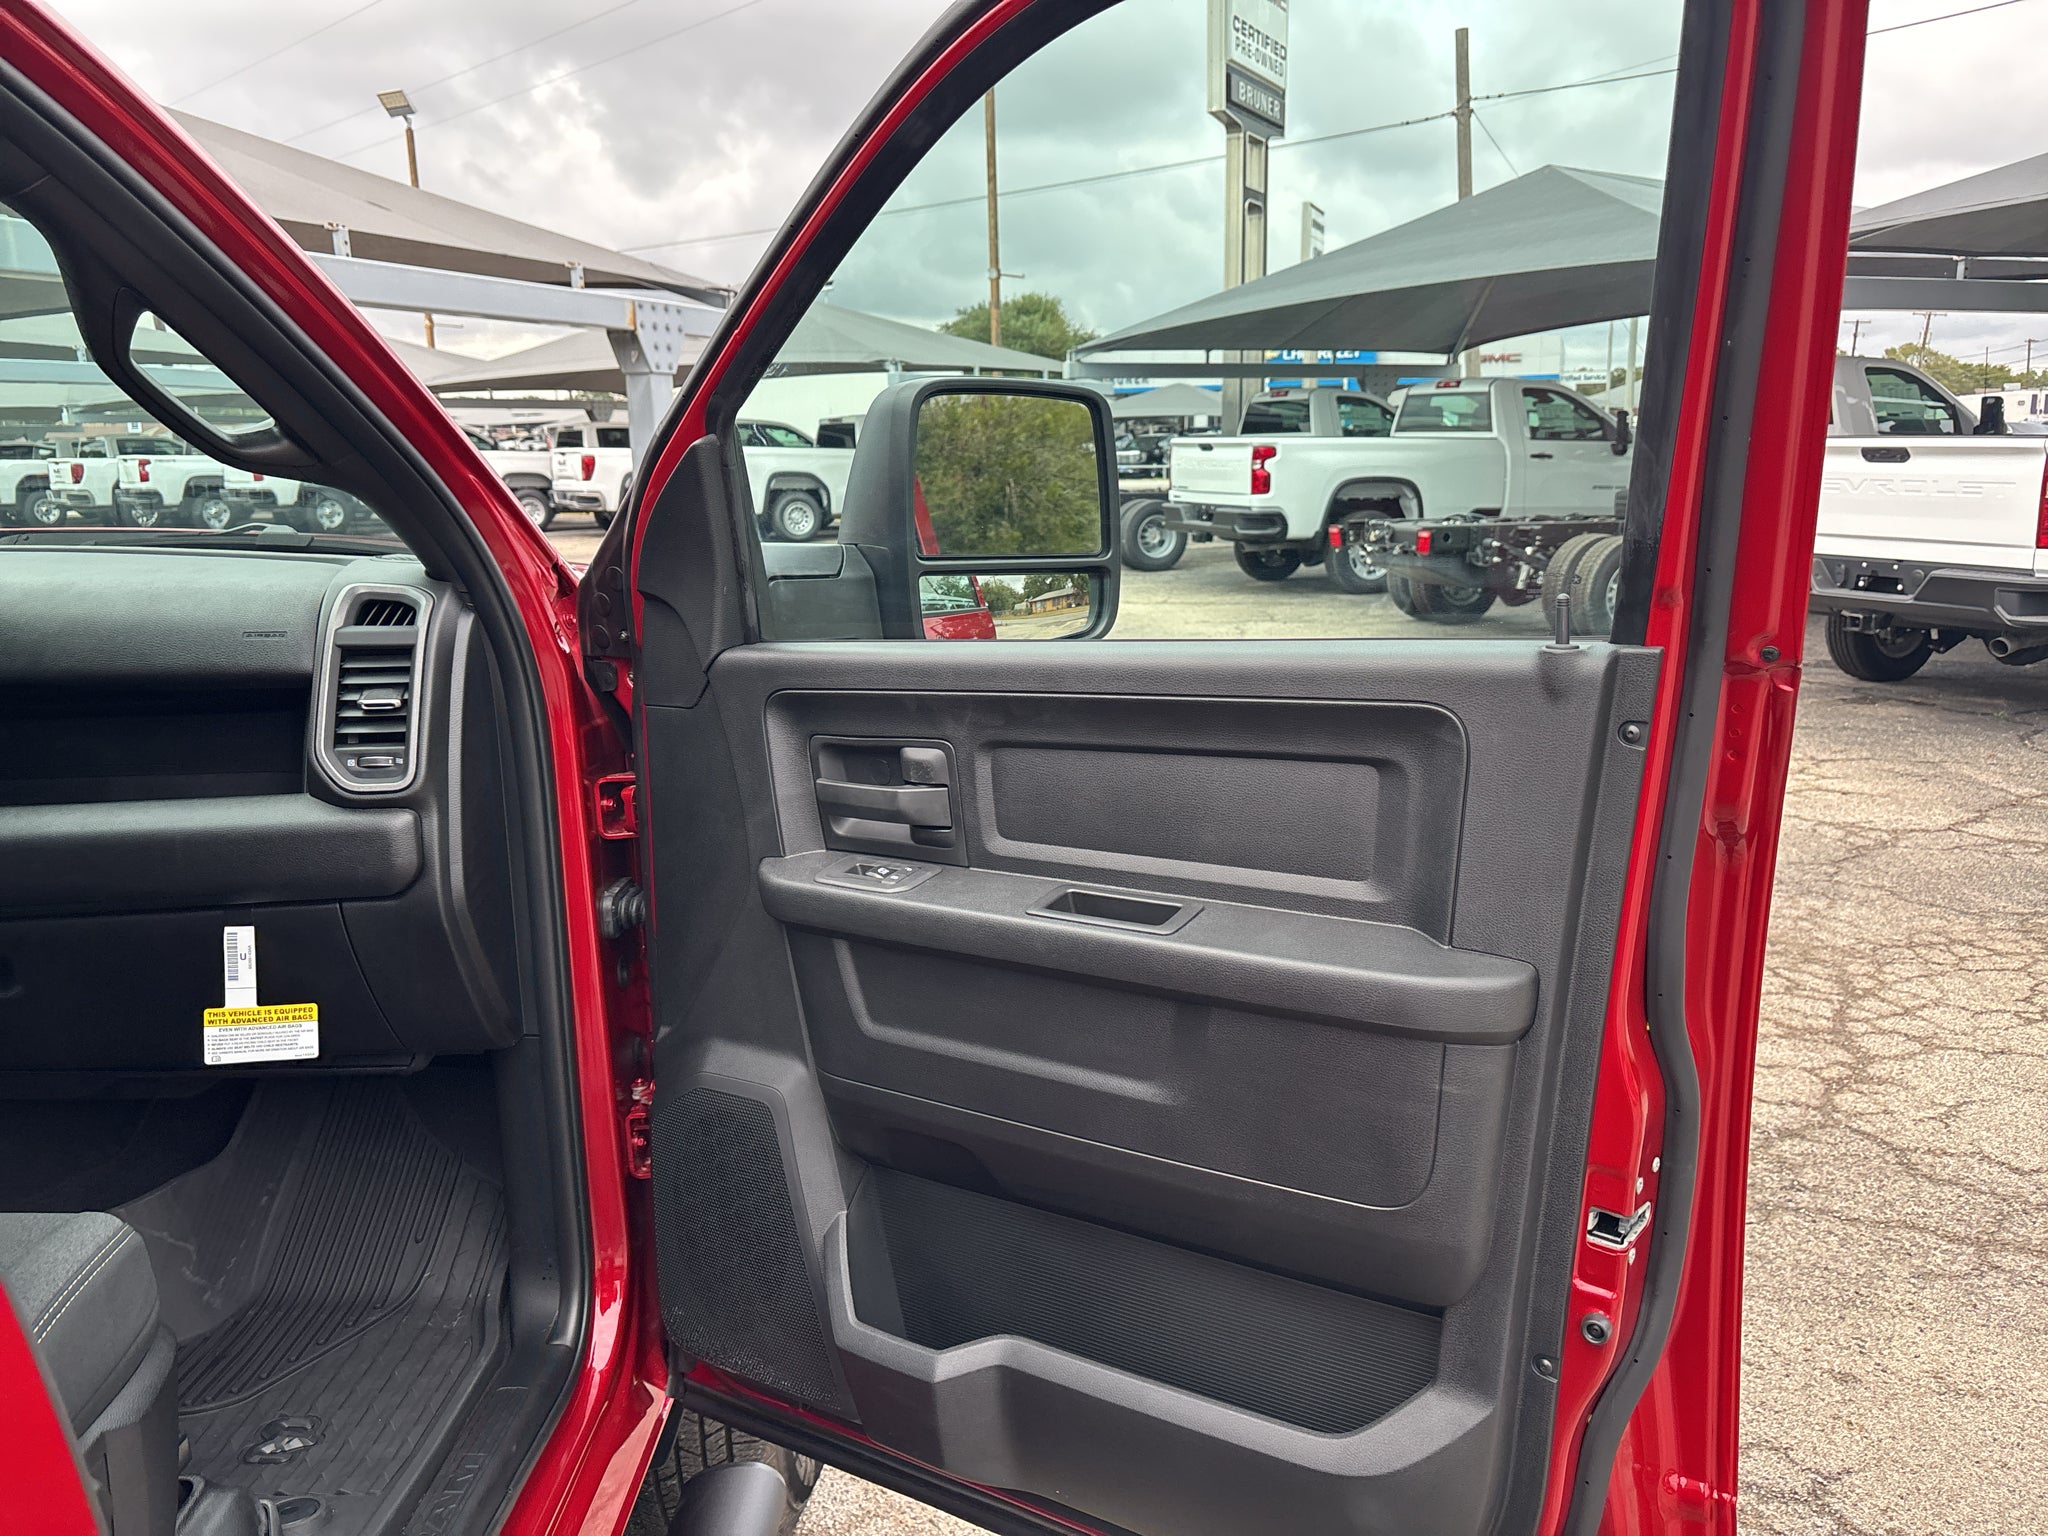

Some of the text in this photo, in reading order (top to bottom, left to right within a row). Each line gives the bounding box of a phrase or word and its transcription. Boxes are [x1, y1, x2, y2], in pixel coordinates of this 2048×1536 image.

[1233, 14, 1287, 60] CERTIFIED
[1235, 35, 1284, 77] PRE-OWNED
[1239, 81, 1280, 120] BRUNER
[1823, 477, 2017, 499] EVROLET
[230, 1015, 274, 1024] ADVANCED
[274, 1007, 314, 1015] EQUIPPED
